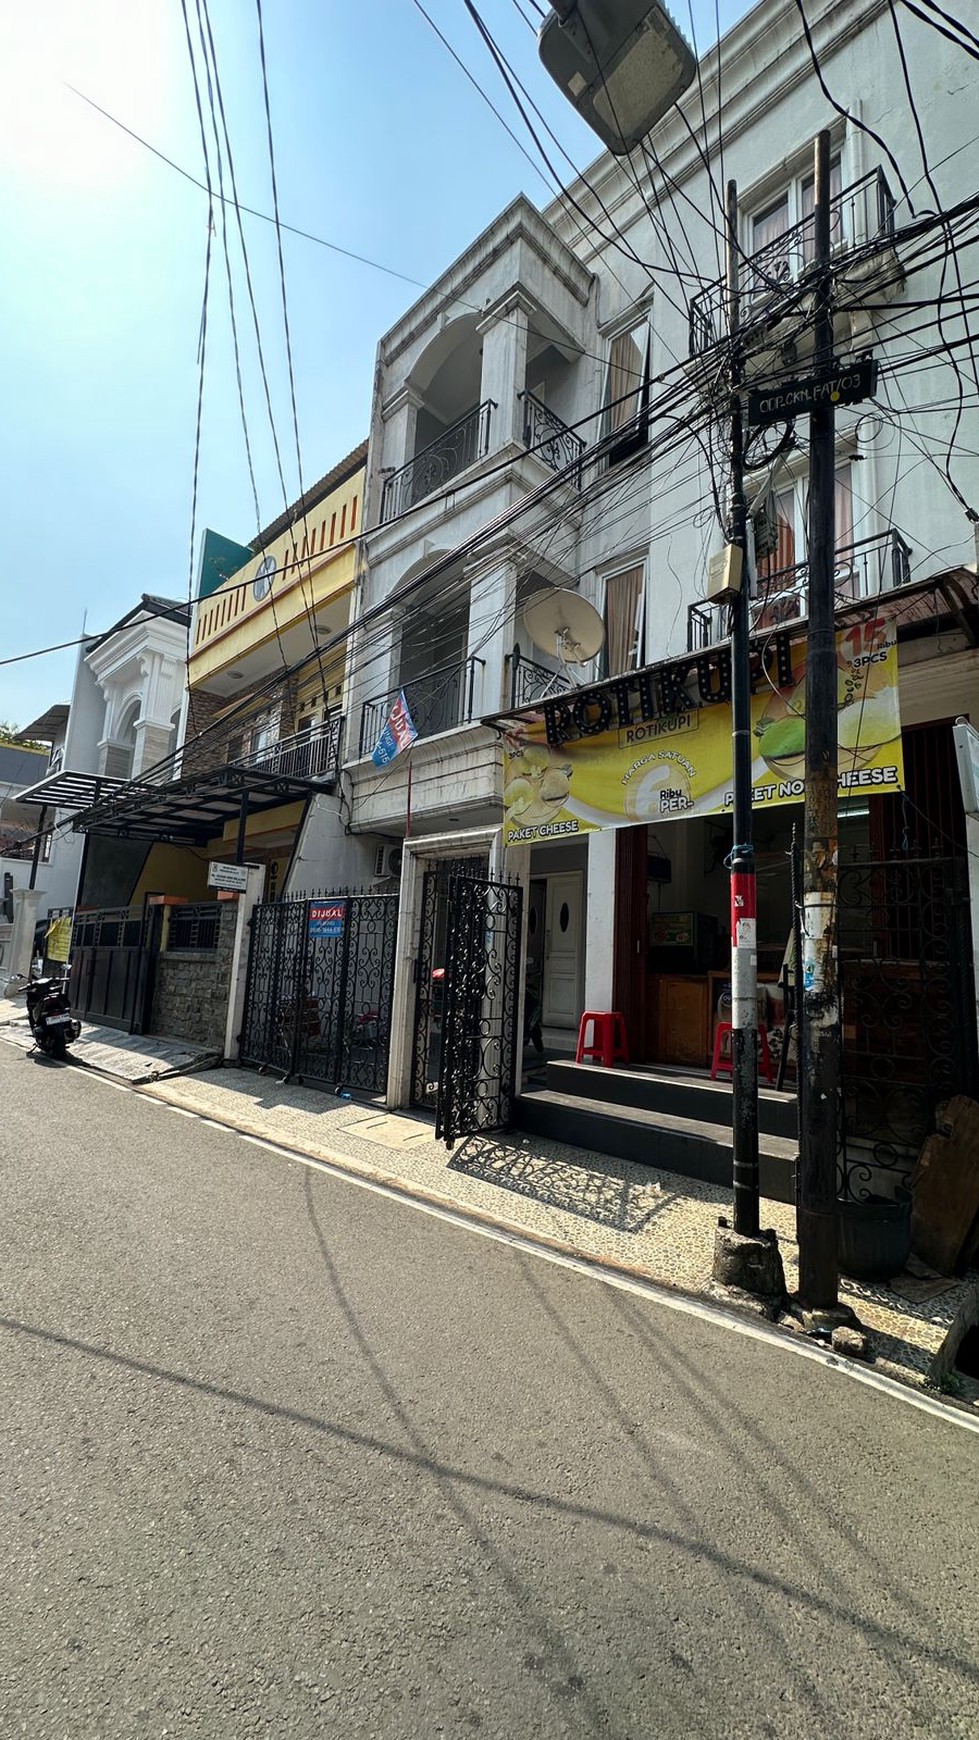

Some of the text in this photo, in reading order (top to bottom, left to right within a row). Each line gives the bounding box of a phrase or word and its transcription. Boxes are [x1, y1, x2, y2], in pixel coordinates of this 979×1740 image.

[845, 618, 886, 657] 15
[854, 651, 888, 667] 3PCS
[626, 714, 691, 743] ROTIKUPI
[621, 750, 697, 786] HARGA SATUAN
[660, 788, 682, 800] Ribu
[724, 766, 898, 806] PET NO HEESE
[507, 820, 579, 842] PAKET CHEESE
